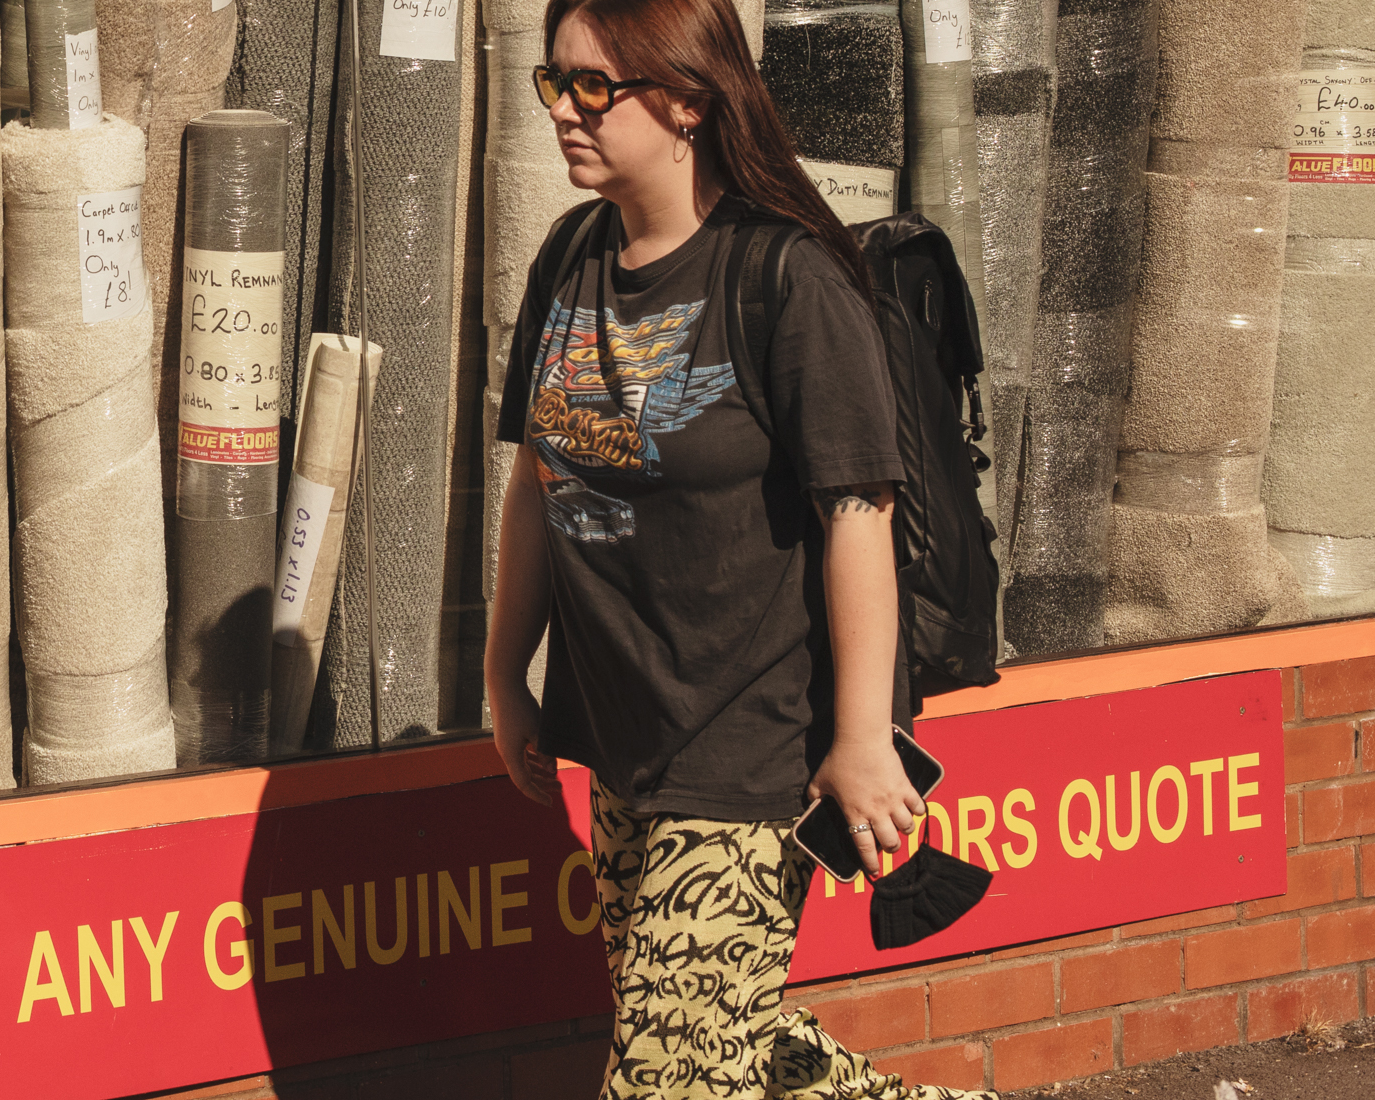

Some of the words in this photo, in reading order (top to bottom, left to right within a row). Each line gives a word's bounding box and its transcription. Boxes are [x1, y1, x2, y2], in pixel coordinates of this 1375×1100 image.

[930, 9, 958, 27] Only
[71, 42, 92, 62] Vinyl
[79, 96, 99, 113] Only
[827, 178, 858, 196] DUTY
[82, 201, 115, 219] Carpet
[86, 255, 119, 277] Only
[191, 294, 277, 333] £20.00
[184, 355, 228, 382] 0.80
[17, 911, 180, 1025] ANY
[204, 859, 532, 991] GENUINE
[1058, 752, 1262, 861] QUOTE
